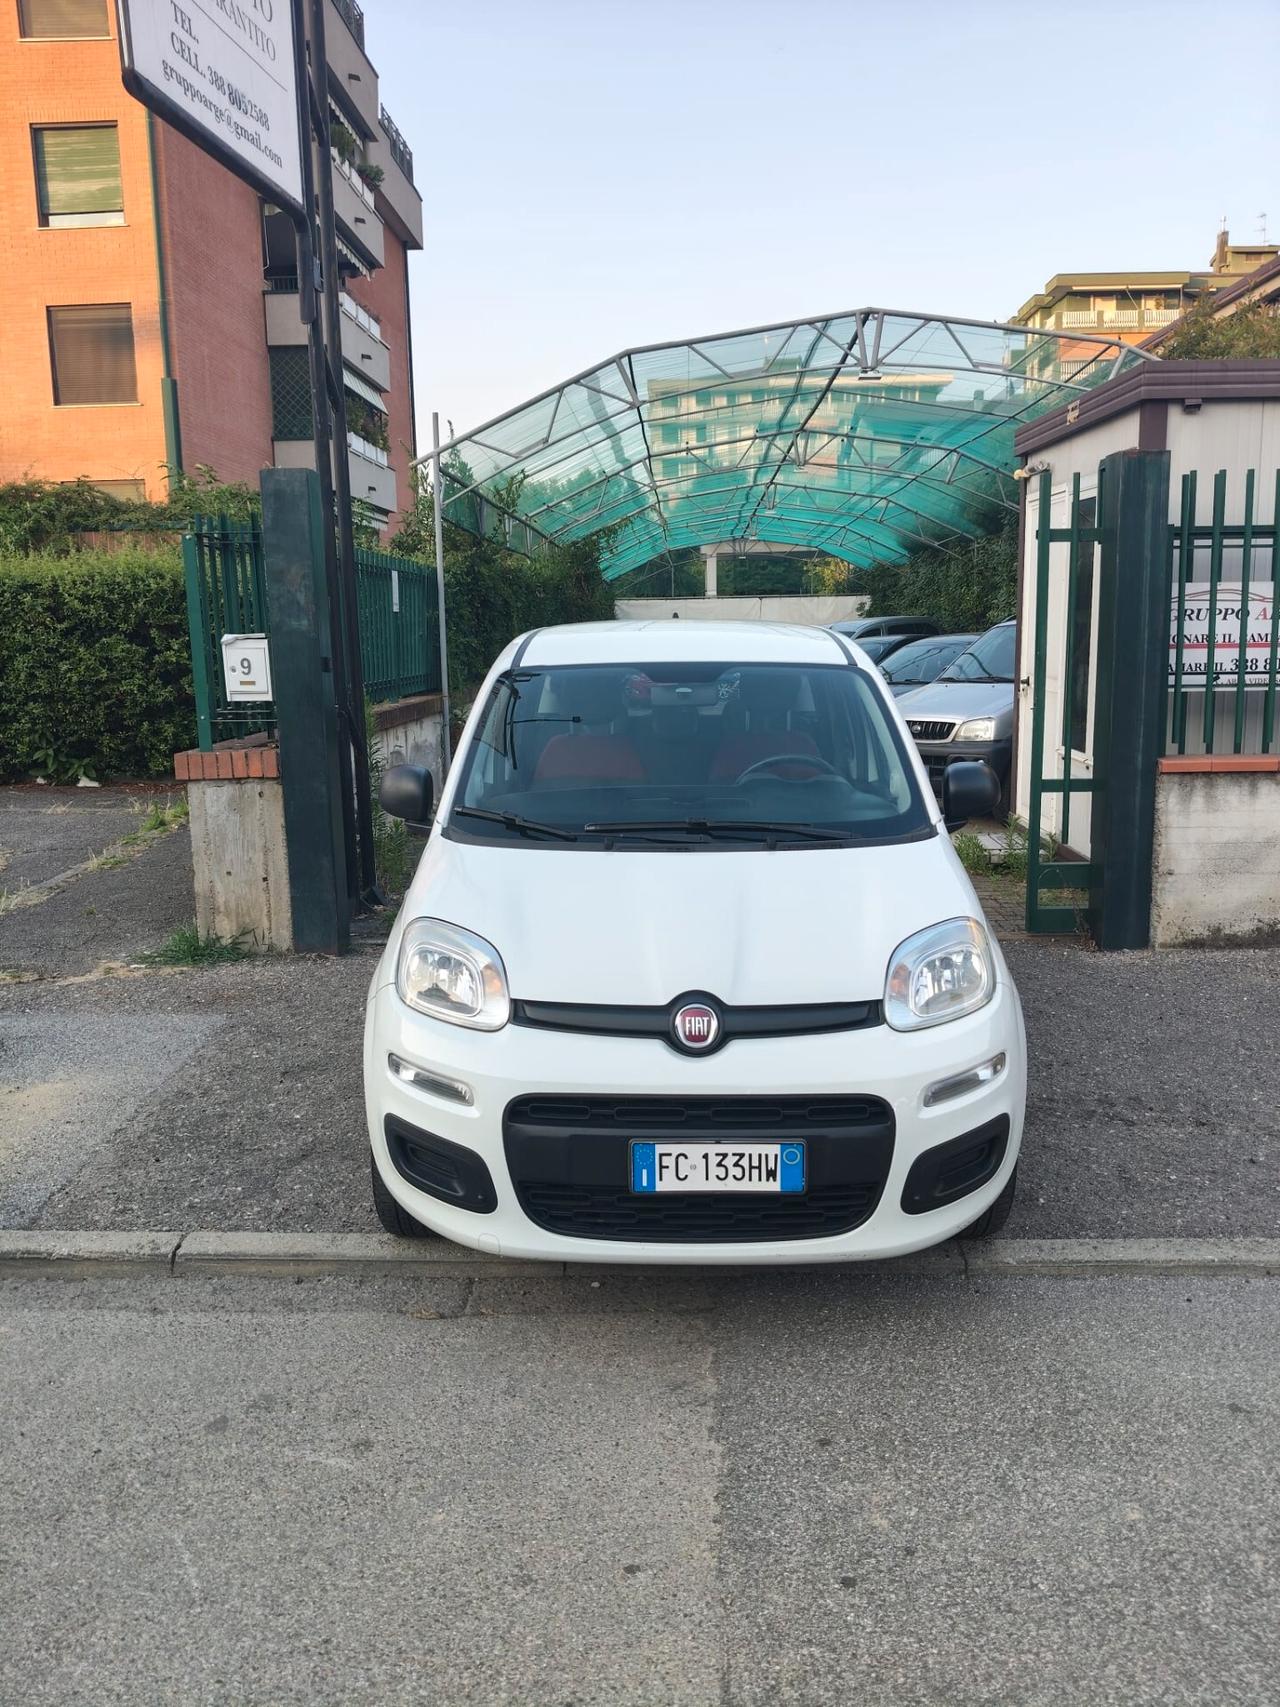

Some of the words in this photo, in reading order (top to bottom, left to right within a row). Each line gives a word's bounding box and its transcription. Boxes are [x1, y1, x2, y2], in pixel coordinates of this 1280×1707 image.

[170, 0, 199, 44] TEL.
[171, 32, 206, 78] CELL.
[208, 65, 226, 95] 388
[162, 59, 283, 168] gruppoarge@gmail.com
[1222, 633, 1236, 643] IL
[240, 657, 252, 676] 9
[1214, 662, 1227, 671] IL
[685, 1016, 710, 1036] FIAT
